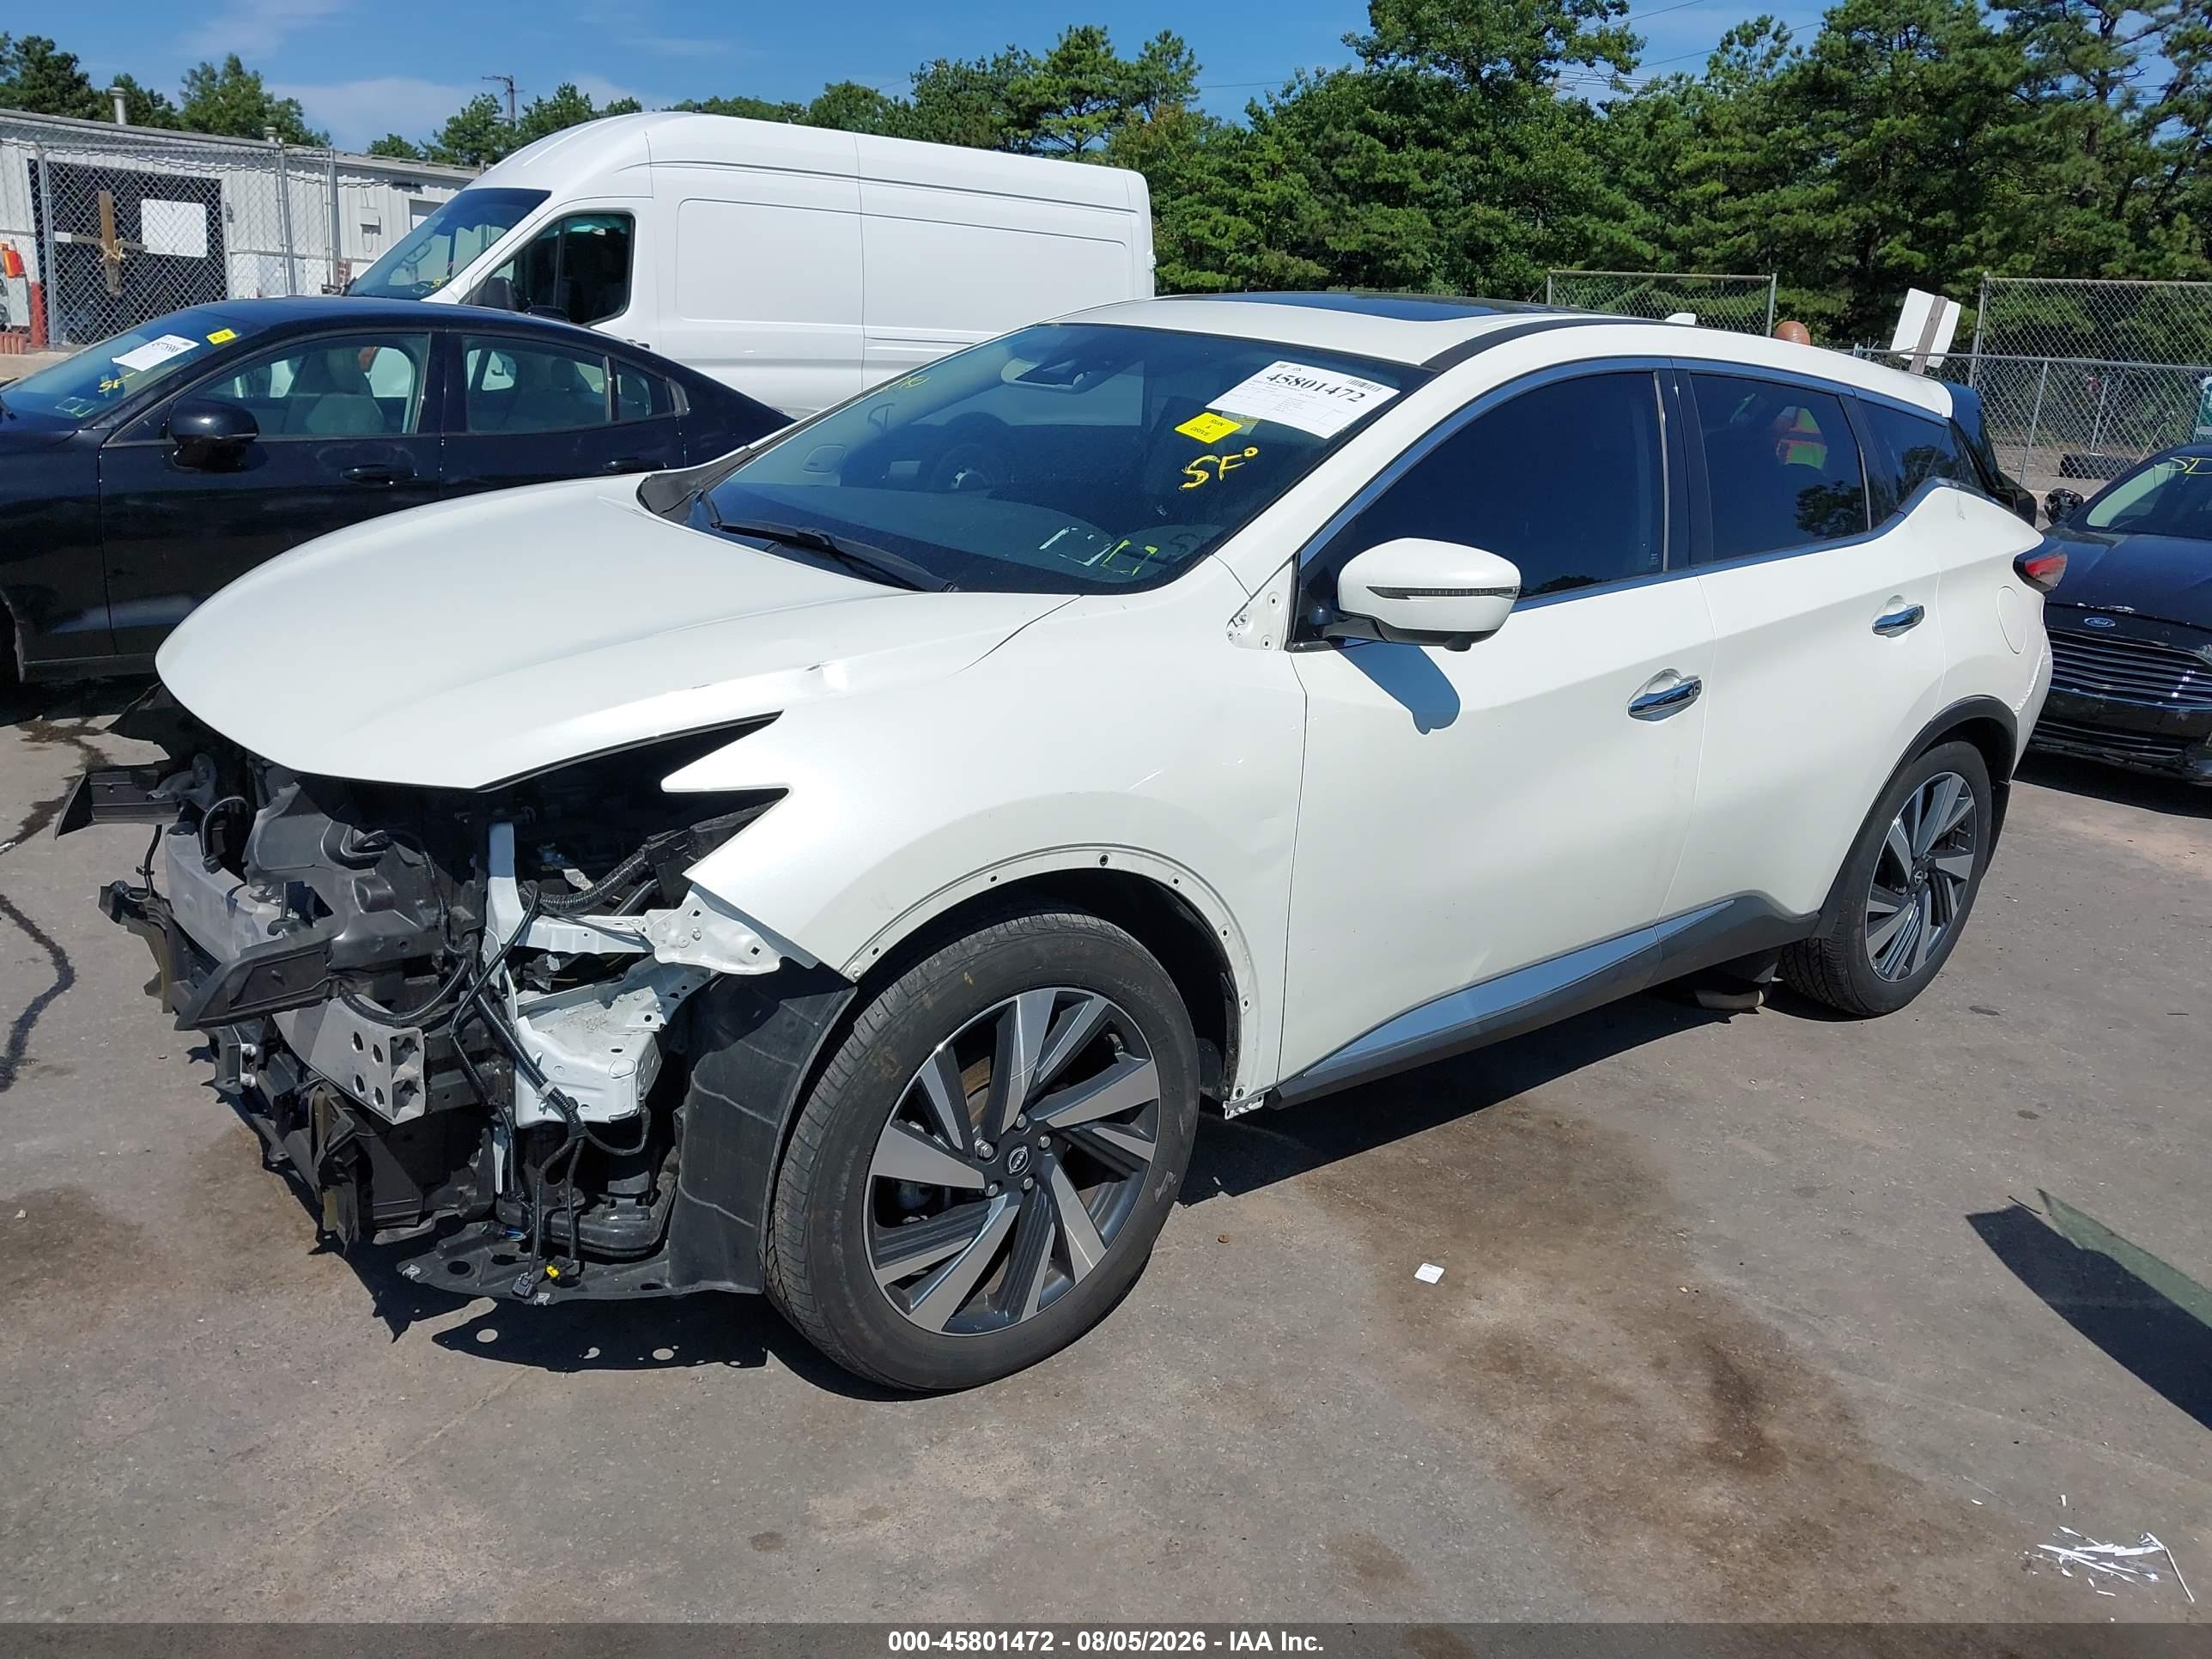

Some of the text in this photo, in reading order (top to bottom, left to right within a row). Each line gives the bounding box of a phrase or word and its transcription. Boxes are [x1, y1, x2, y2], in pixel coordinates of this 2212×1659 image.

[1266, 373, 1366, 403] 45801472
[1209, 418, 1225, 427] RUN
[1189, 426, 1212, 437] DRIVE
